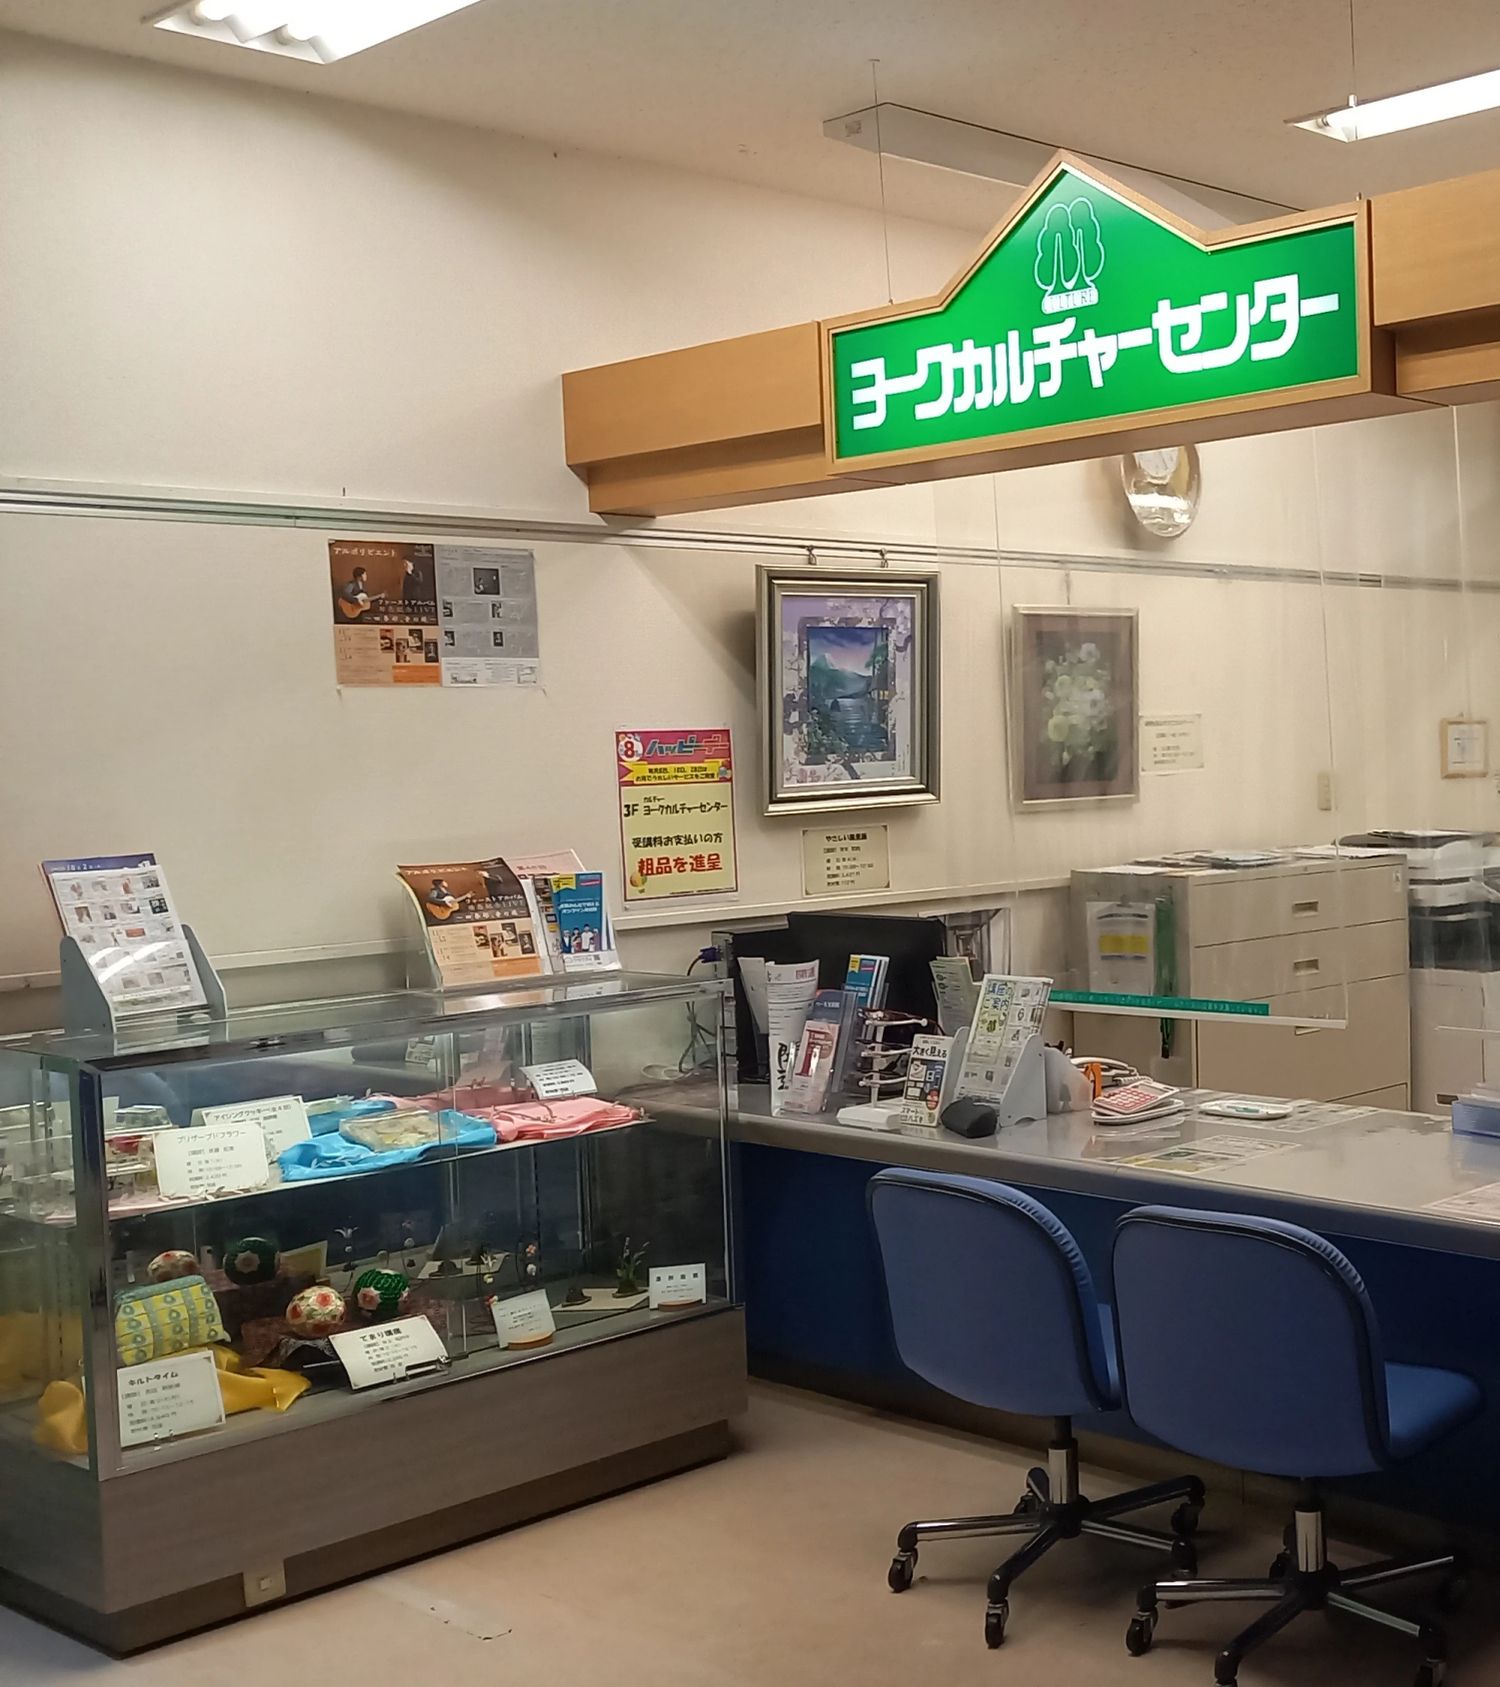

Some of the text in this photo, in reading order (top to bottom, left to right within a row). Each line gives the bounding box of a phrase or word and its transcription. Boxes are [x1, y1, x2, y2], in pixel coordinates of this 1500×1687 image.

[850, 273, 1340, 431] ヨークカルチャーセンター
[624, 802, 728, 818] 3F ヨークカルチャーセンター
[632, 832, 724, 849] 受講料お支払いの方
[637, 852, 723, 877] 粗品を進呈
